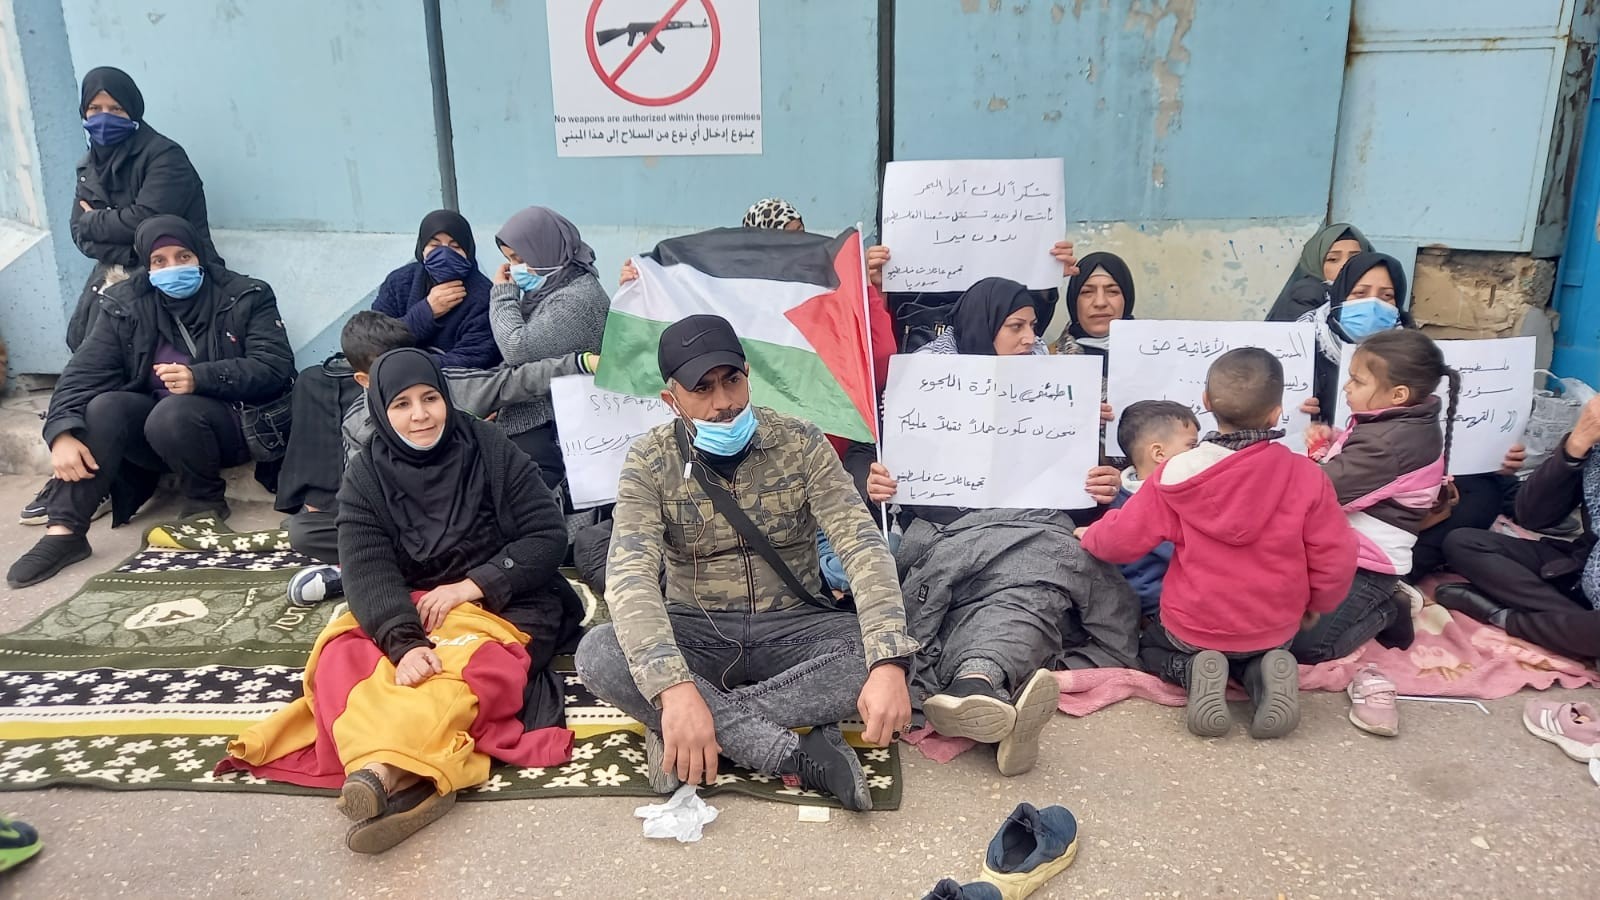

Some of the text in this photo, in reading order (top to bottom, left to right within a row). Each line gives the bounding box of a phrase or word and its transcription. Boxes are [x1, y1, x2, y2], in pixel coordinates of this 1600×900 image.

[554, 115, 566, 123] No
[568, 115, 605, 125] weapons
[622, 113, 666, 122] authorized
[668, 113, 694, 121] within
[696, 113, 719, 121] these
[722, 112, 760, 123] premises
[589, 128, 604, 139] هذا
[606, 128, 618, 143] إلى
[621, 128, 654, 143] السلاح
[656, 130, 669, 142] من
[671, 128, 687, 143] نوع
[690, 124, 700, 145] أي
[702, 128, 728, 142] إدخال
